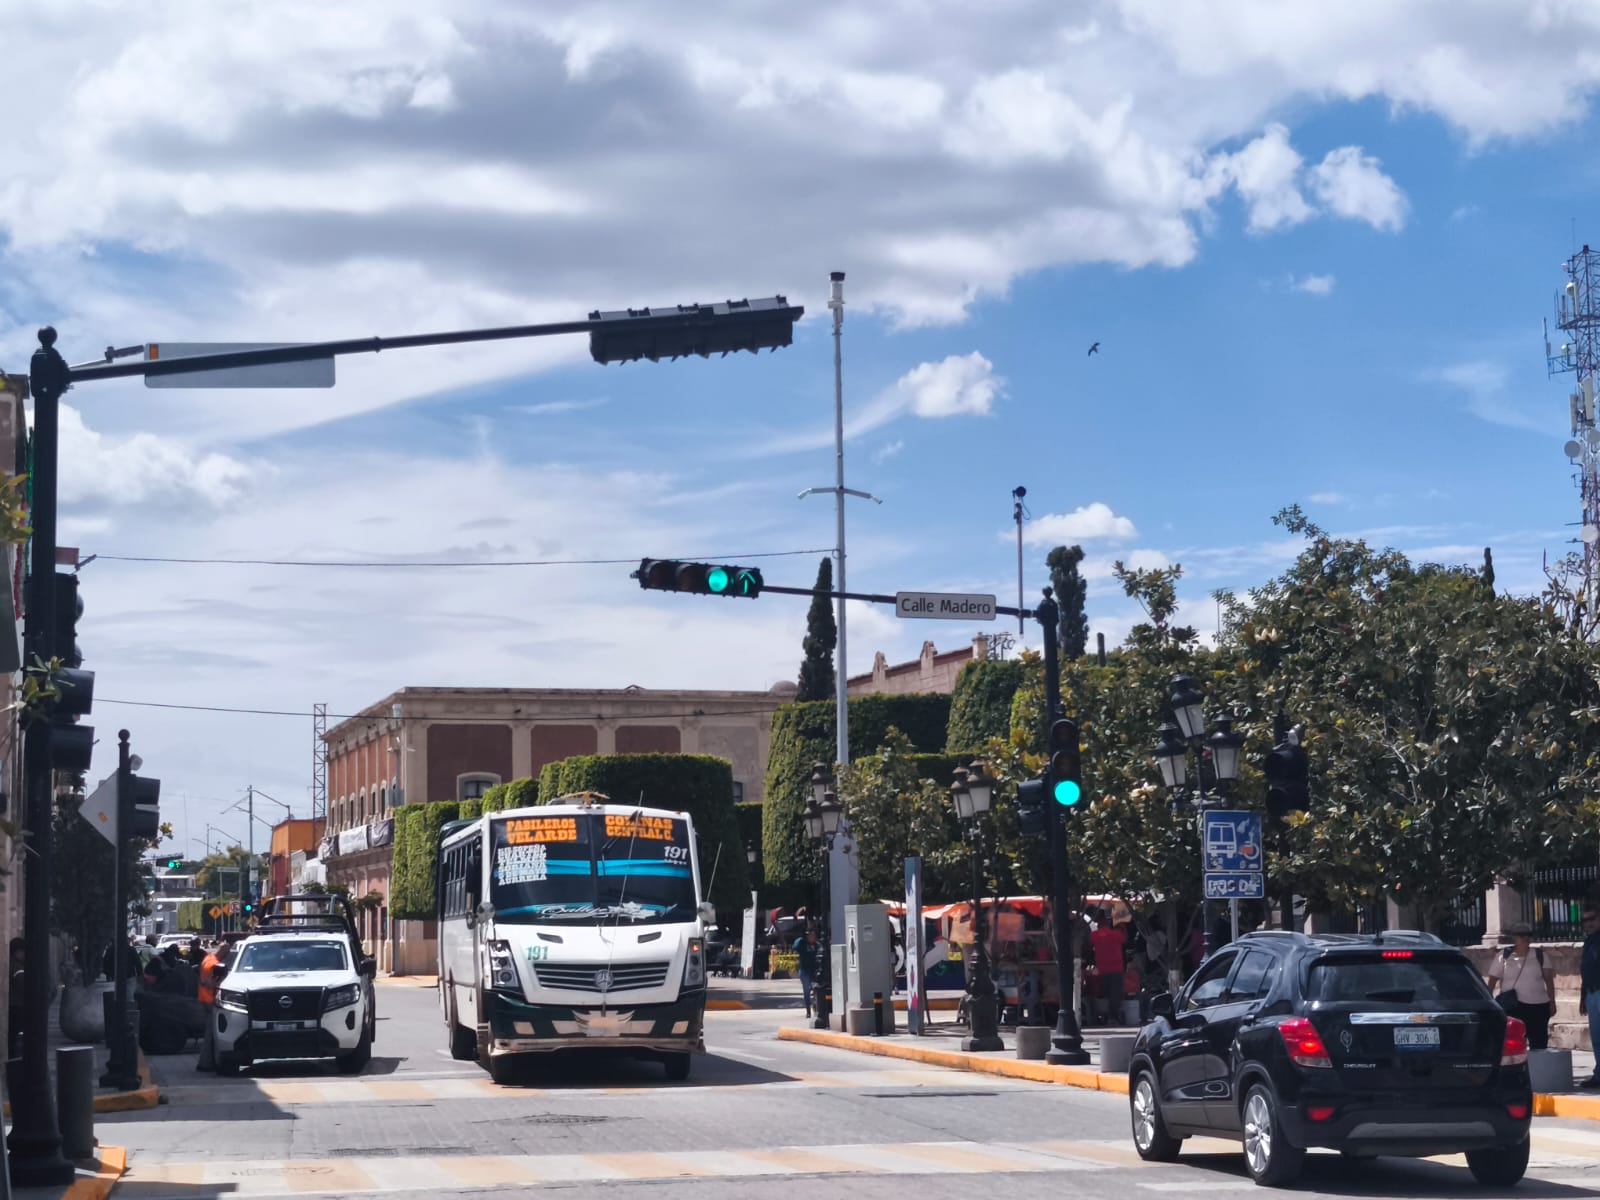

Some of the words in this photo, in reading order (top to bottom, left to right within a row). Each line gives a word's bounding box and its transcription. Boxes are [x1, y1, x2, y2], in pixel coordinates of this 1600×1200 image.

[901, 598, 935, 613] Calle
[940, 600, 991, 614] Madero
[507, 829, 577, 844] VELARDE
[664, 845, 689, 860] 191
[526, 946, 548, 960] 191
